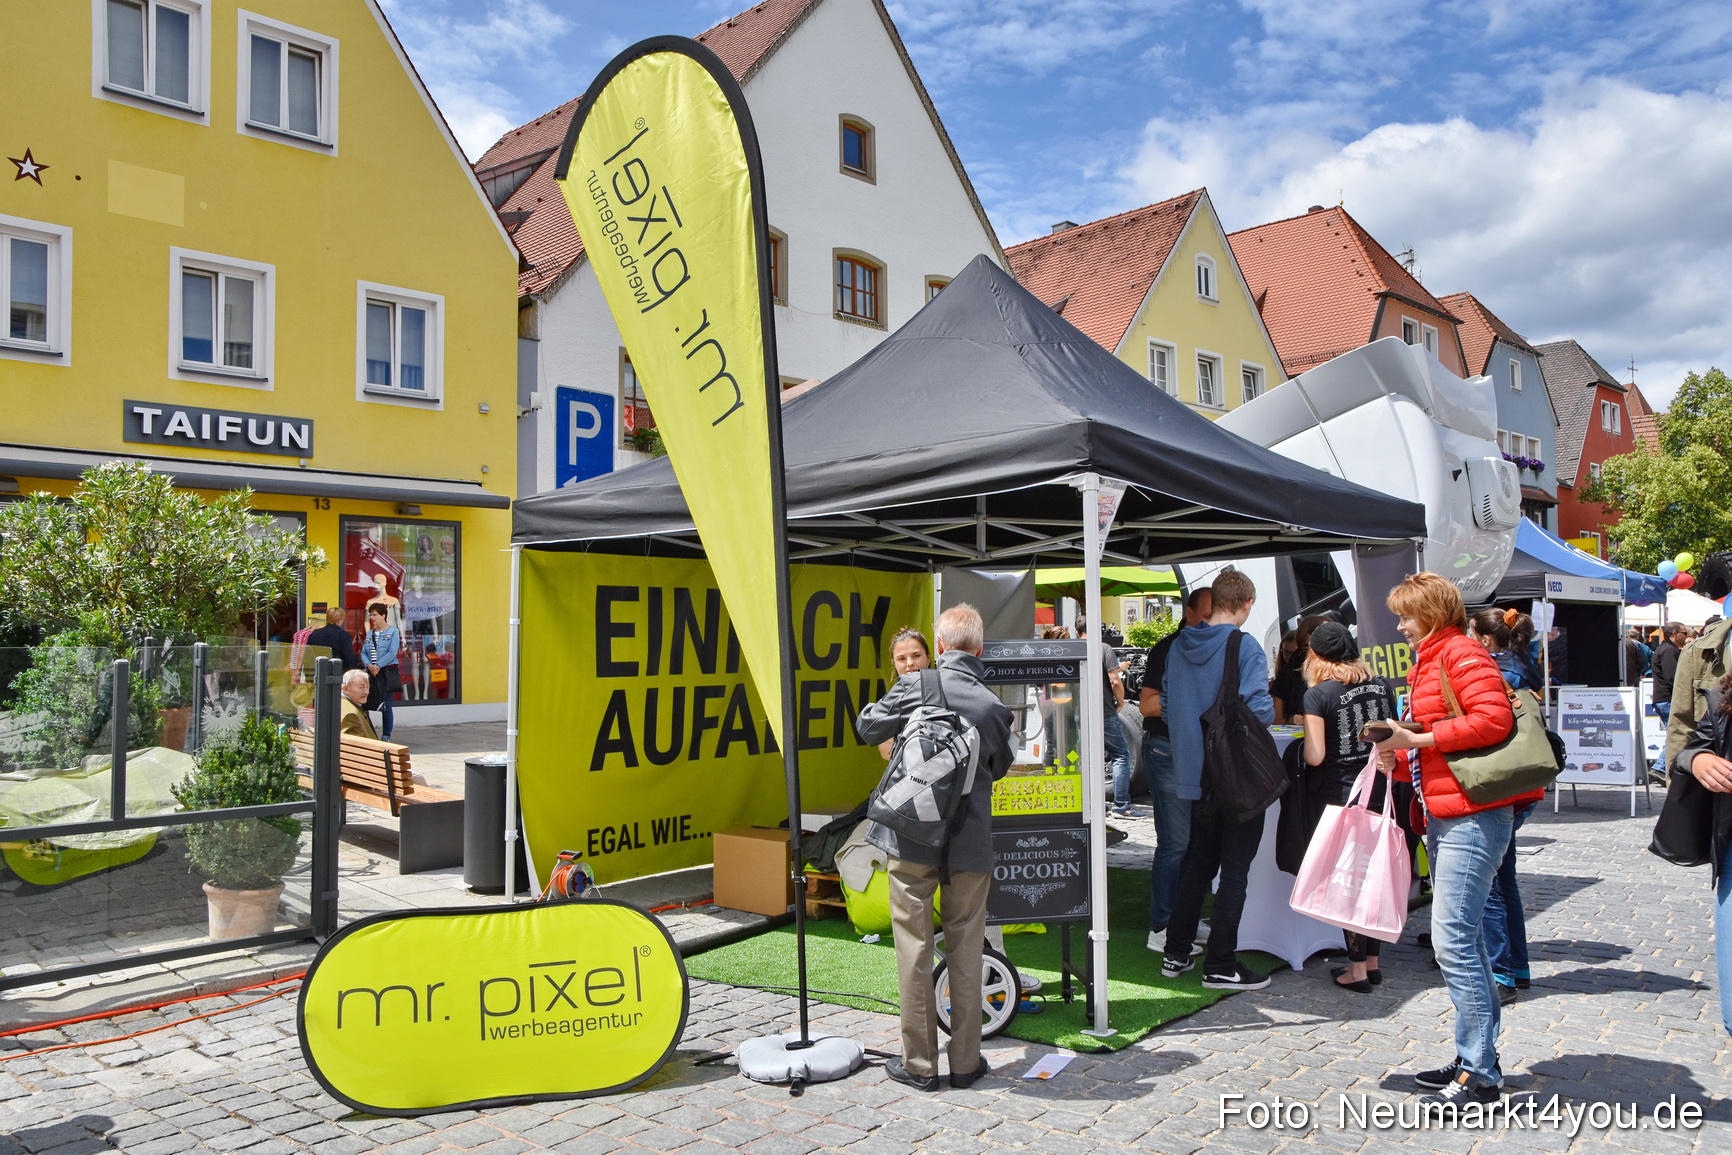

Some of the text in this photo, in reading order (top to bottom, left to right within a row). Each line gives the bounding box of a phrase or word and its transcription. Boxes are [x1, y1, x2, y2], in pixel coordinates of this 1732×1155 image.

[133, 406, 309, 449] TAIFUN
[569, 400, 602, 466] P
[313, 497, 331, 511] 13
[1547, 581, 1563, 593] IVECO
[595, 584, 892, 678] EINCH
[997, 668, 1017, 676] HOT
[1026, 667, 1054, 675] FRESH
[909, 775, 928, 786] THULE
[1011, 795, 1076, 811] KNALLT!
[587, 814, 713, 857] EGAL WIE...
[1003, 850, 1060, 860] DELICIOUS
[993, 861, 1081, 881] OPCORN
[336, 981, 451, 1030] mr.
[488, 1011, 644, 1041] werbeagentur
